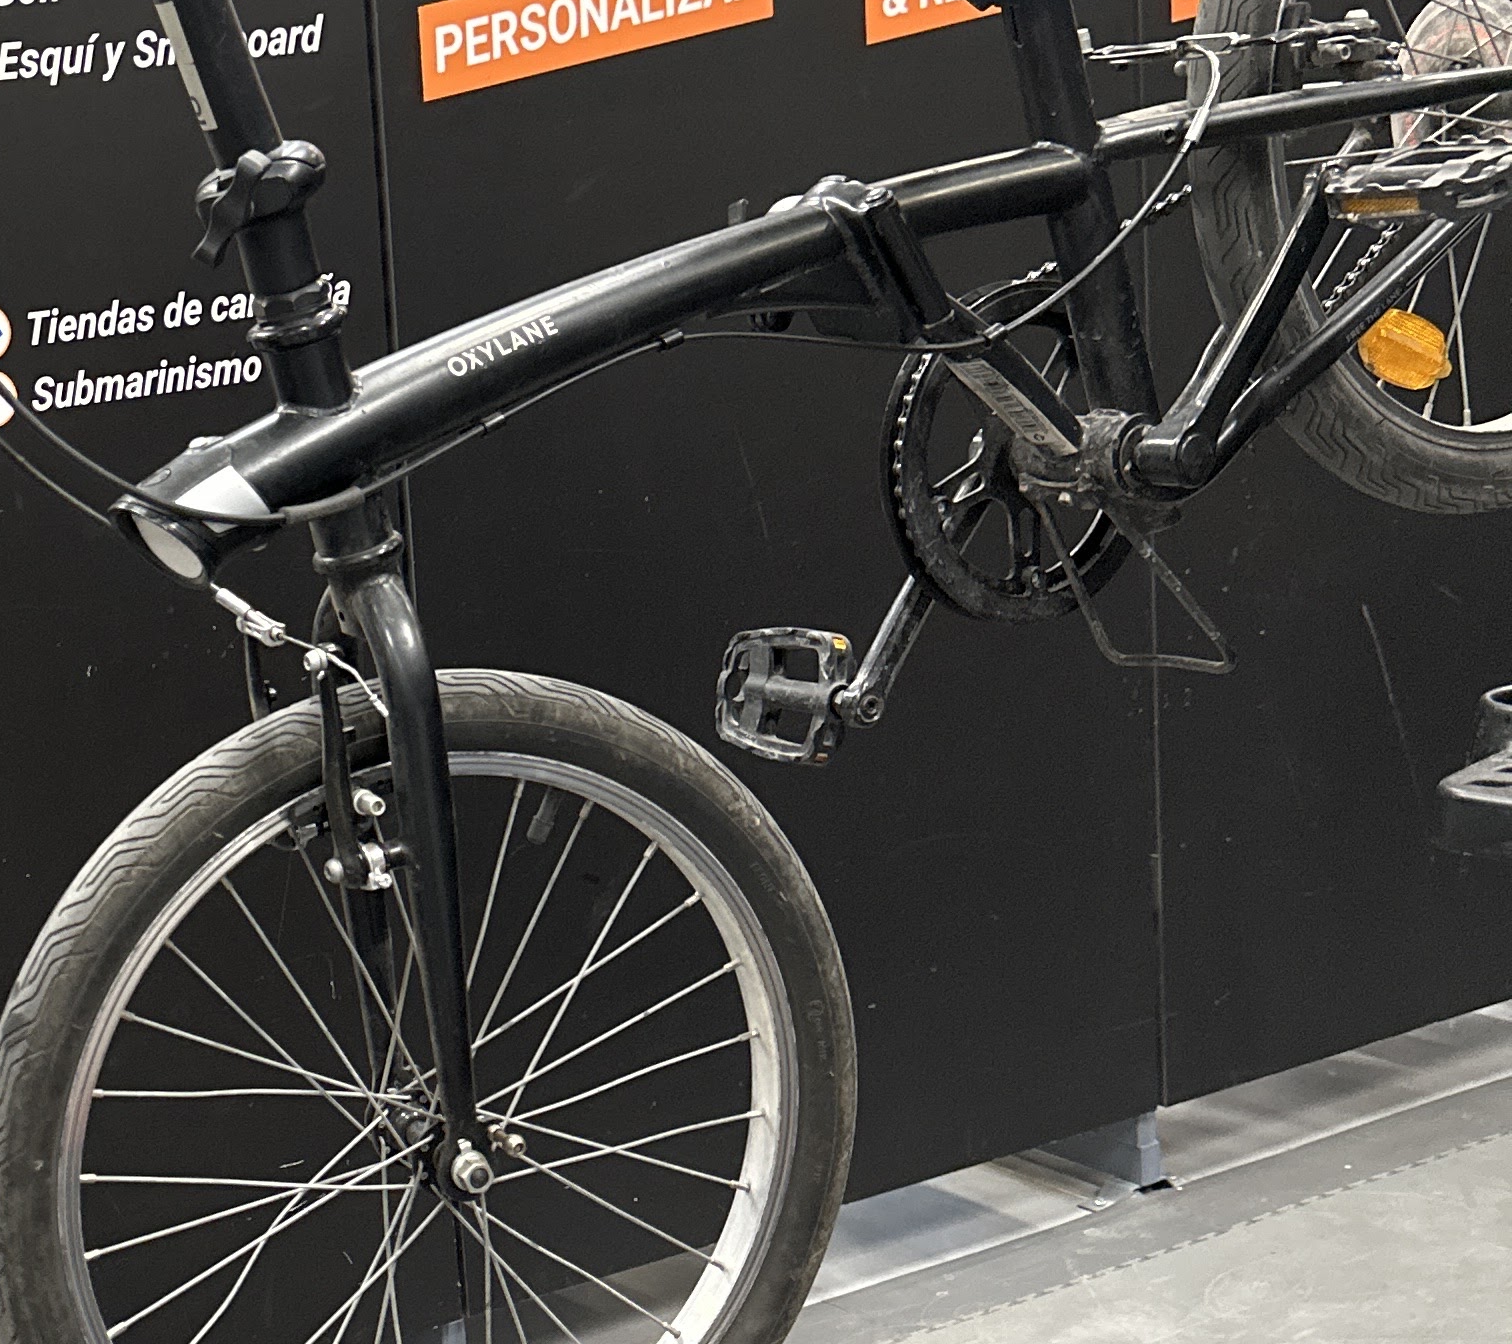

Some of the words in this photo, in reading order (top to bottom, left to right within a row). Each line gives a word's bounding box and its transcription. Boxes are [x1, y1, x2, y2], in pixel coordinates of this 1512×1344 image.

[103, 40, 125, 82] y
[133, 13, 325, 69] Snoard
[28, 299, 155, 346] Tiendas
[163, 290, 203, 329] de
[447, 315, 559, 377] OXYLANE
[31, 356, 263, 413] Submarinismo
